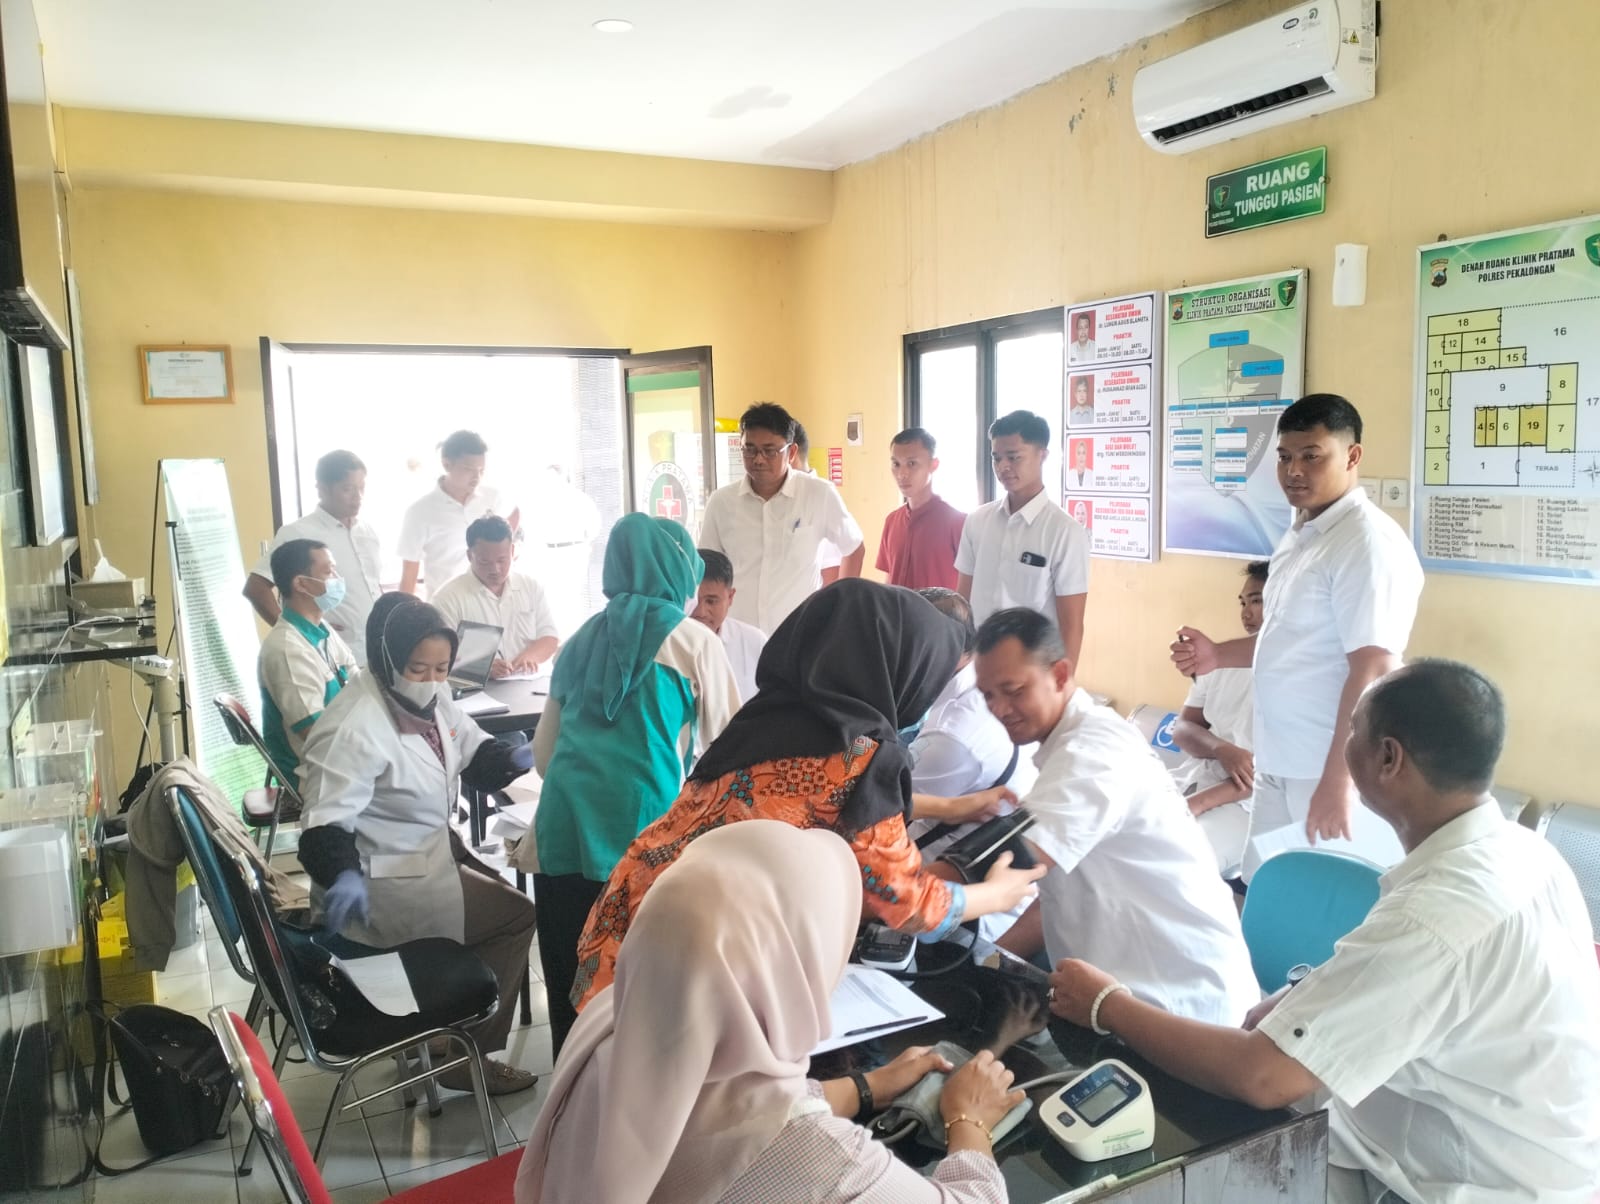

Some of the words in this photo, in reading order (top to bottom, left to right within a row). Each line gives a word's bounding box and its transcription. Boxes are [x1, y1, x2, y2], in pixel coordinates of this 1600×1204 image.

[1247, 162, 1310, 193] RUANG
[1235, 192, 1278, 216] TUNGGU
[1282, 182, 1321, 206] PASIEN
[1462, 262, 1484, 273] DENAH
[1486, 258, 1510, 268] RUANG
[1512, 254, 1536, 265] KLINIK
[1539, 248, 1575, 260] PRATAMA
[1478, 272, 1504, 283] POLRES
[1506, 264, 1555, 279] PEKALONGAN
[1192, 294, 1225, 307] STRUKTUR
[1229, 288, 1270, 302] ORGANISASI
[1203, 307, 1223, 318] PRATAMA
[1244, 300, 1275, 311] PEKALONGAN
[1554, 328, 1567, 336] 16
[1586, 398, 1599, 406] 17
